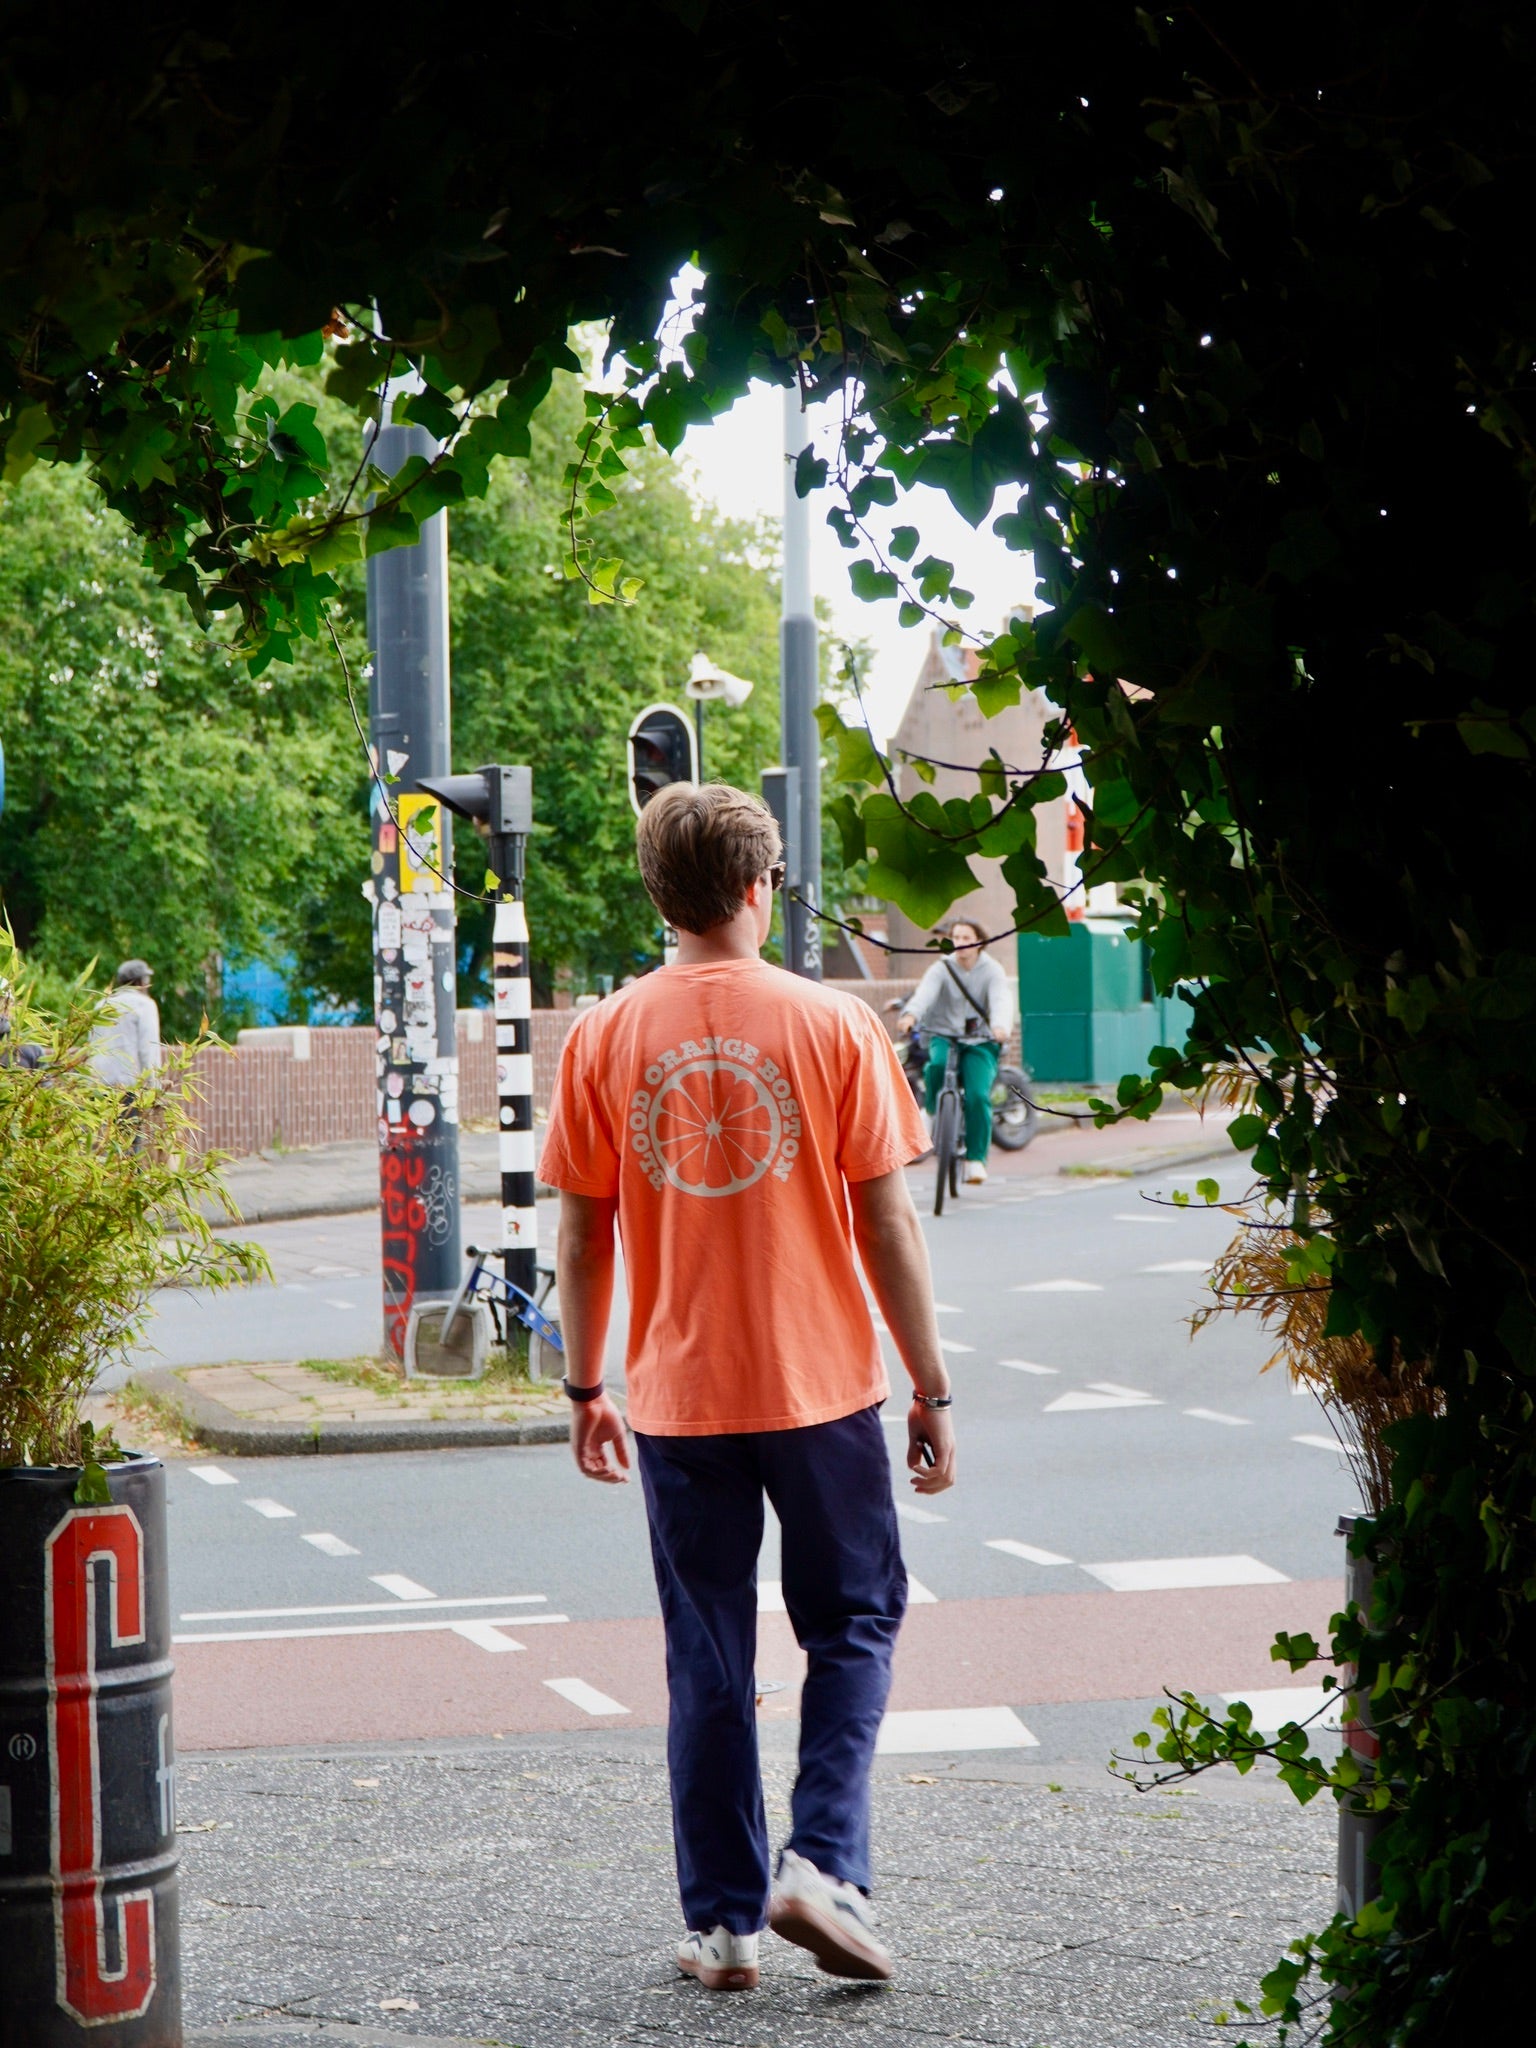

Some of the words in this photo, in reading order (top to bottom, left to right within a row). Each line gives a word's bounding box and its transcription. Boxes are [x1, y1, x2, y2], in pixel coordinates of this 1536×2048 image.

[645, 1036, 760, 1085] ORANGE
[629, 1090, 667, 1191] BLOOD
[757, 1058, 802, 1183] BOSTON
